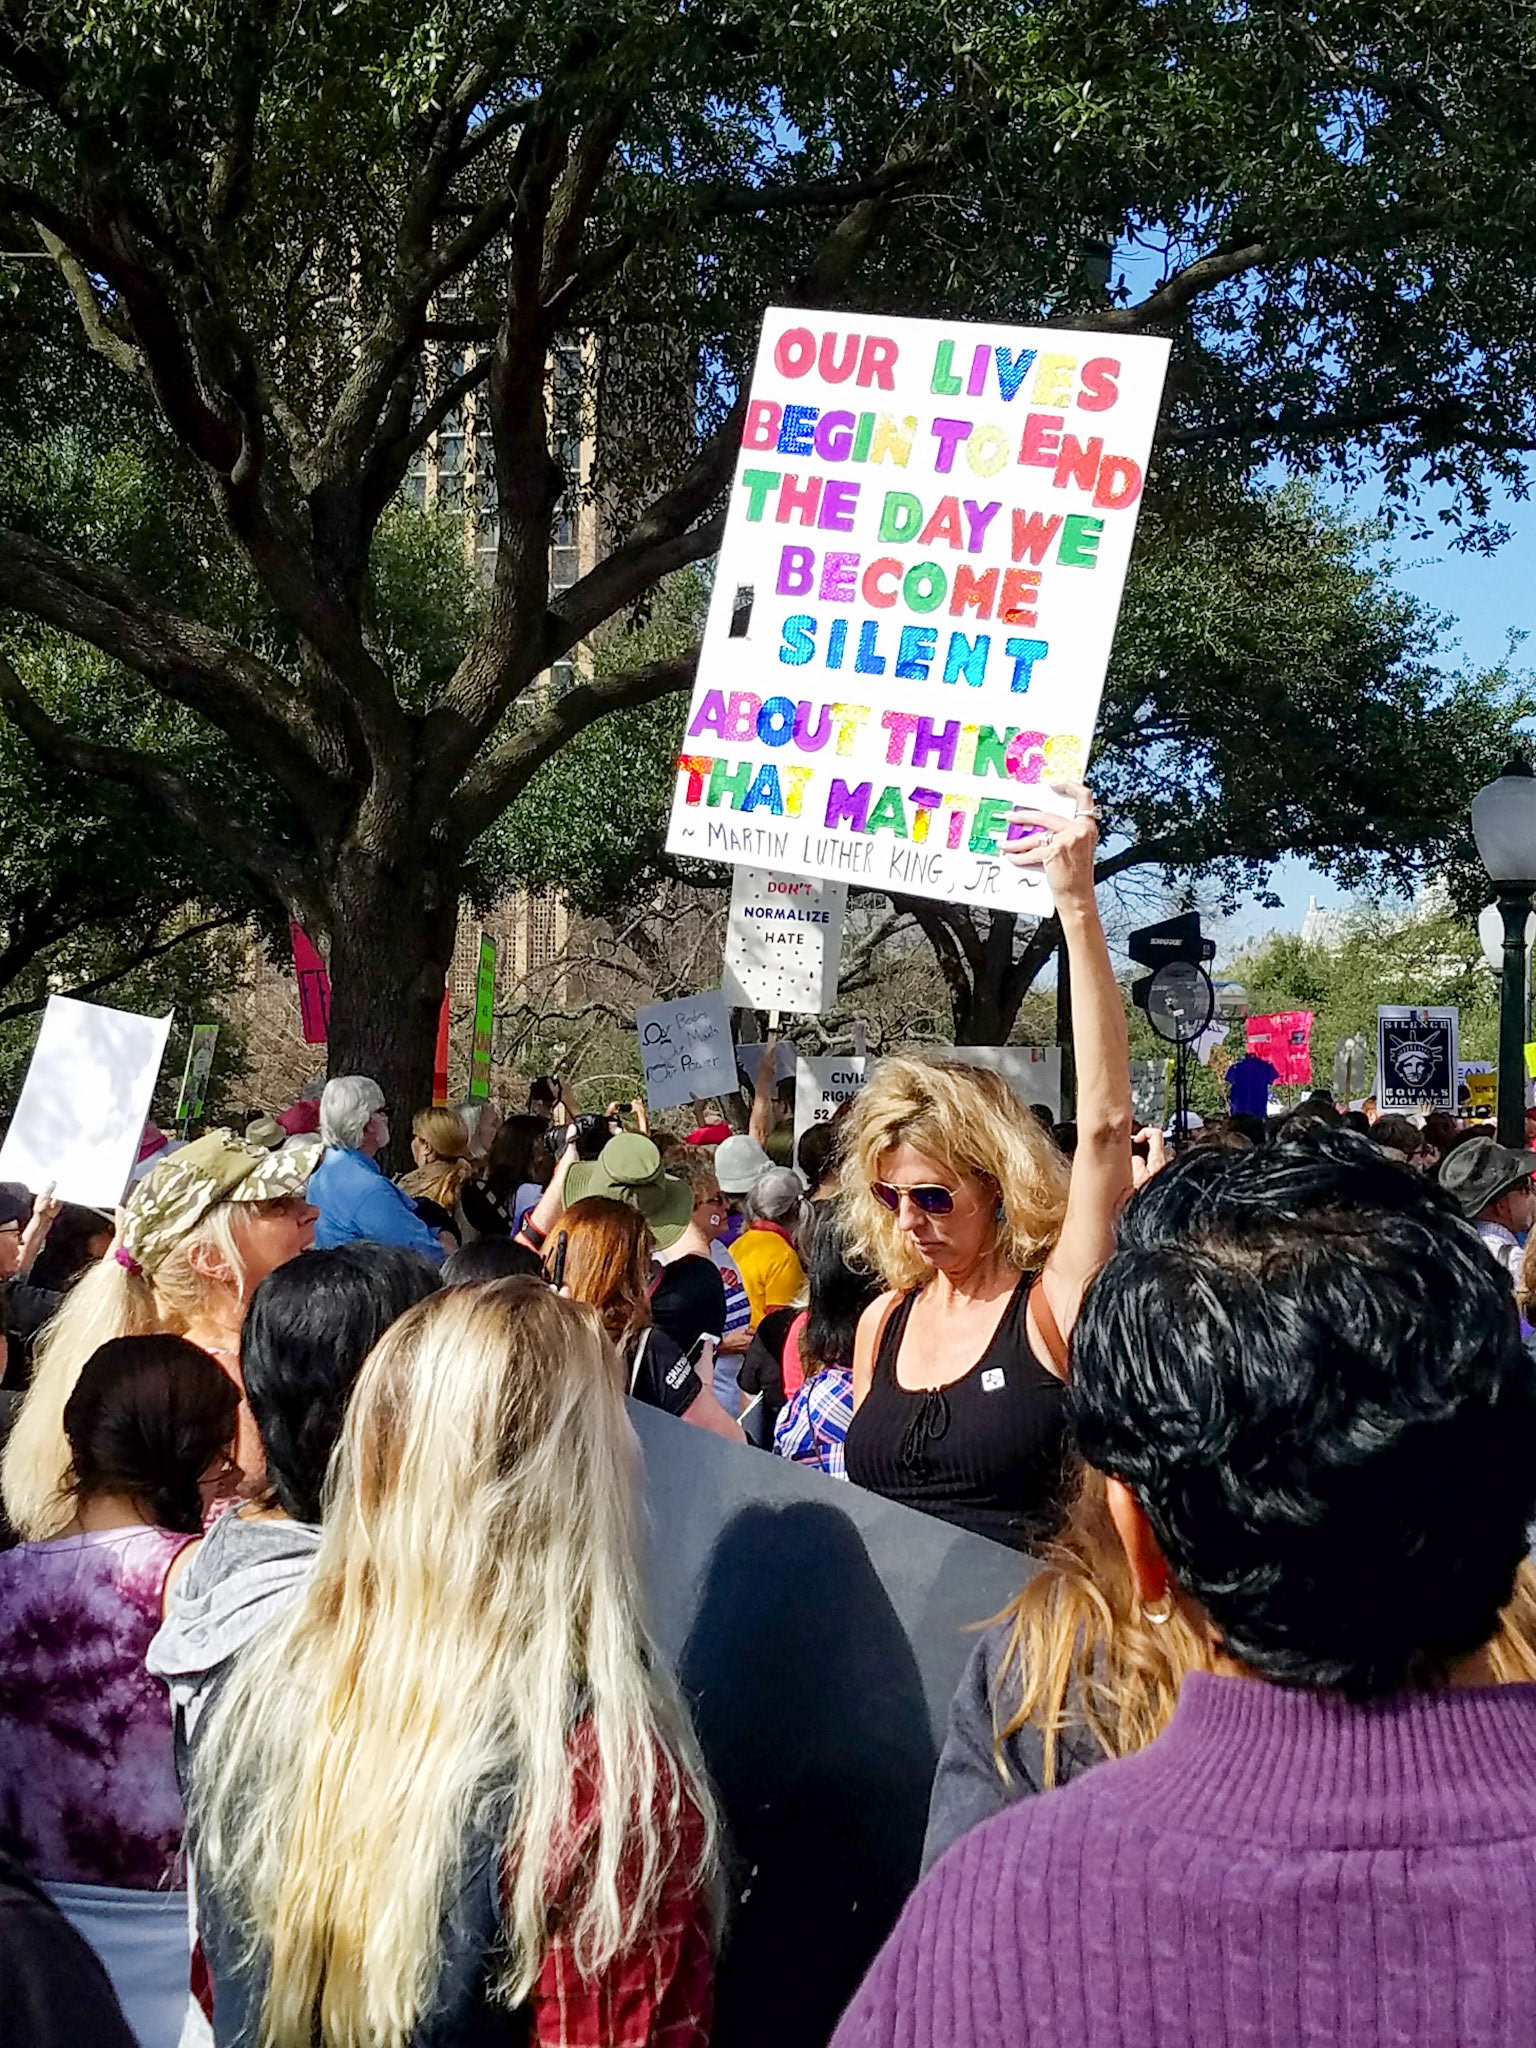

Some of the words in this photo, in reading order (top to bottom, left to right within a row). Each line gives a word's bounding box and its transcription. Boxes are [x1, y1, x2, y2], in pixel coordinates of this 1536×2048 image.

[774, 327, 899, 391] OUR
[930, 339, 1121, 412] LIVES
[742, 399, 918, 468] BEGIN
[931, 417, 1011, 478] TO
[1017, 413, 1143, 510] END
[742, 469, 862, 532] THE
[877, 491, 1002, 553] DAY
[1011, 508, 1106, 569] WE
[775, 545, 1043, 627] BECOME
[778, 614, 1049, 694] SILENT
[687, 689, 872, 756] ABOUT
[881, 710, 1083, 785] THINGS
[677, 754, 816, 819] THAT
[708, 822, 789, 859] MARTIN
[803, 834, 875, 874] LUTHER
[889, 846, 955, 893] KING,
[768, 882, 812, 896] DON'T
[744, 907, 830, 923] NORMALIZE
[765, 932, 804, 944] HATE
[1150, 938, 1183, 946] SHURE
[1384, 1021, 1448, 1029] SILENCE
[1385, 1088, 1449, 1096] EQUALS
[1385, 1097, 1450, 1105] VIOLENCE
[814, 1109, 829, 1120] 52
